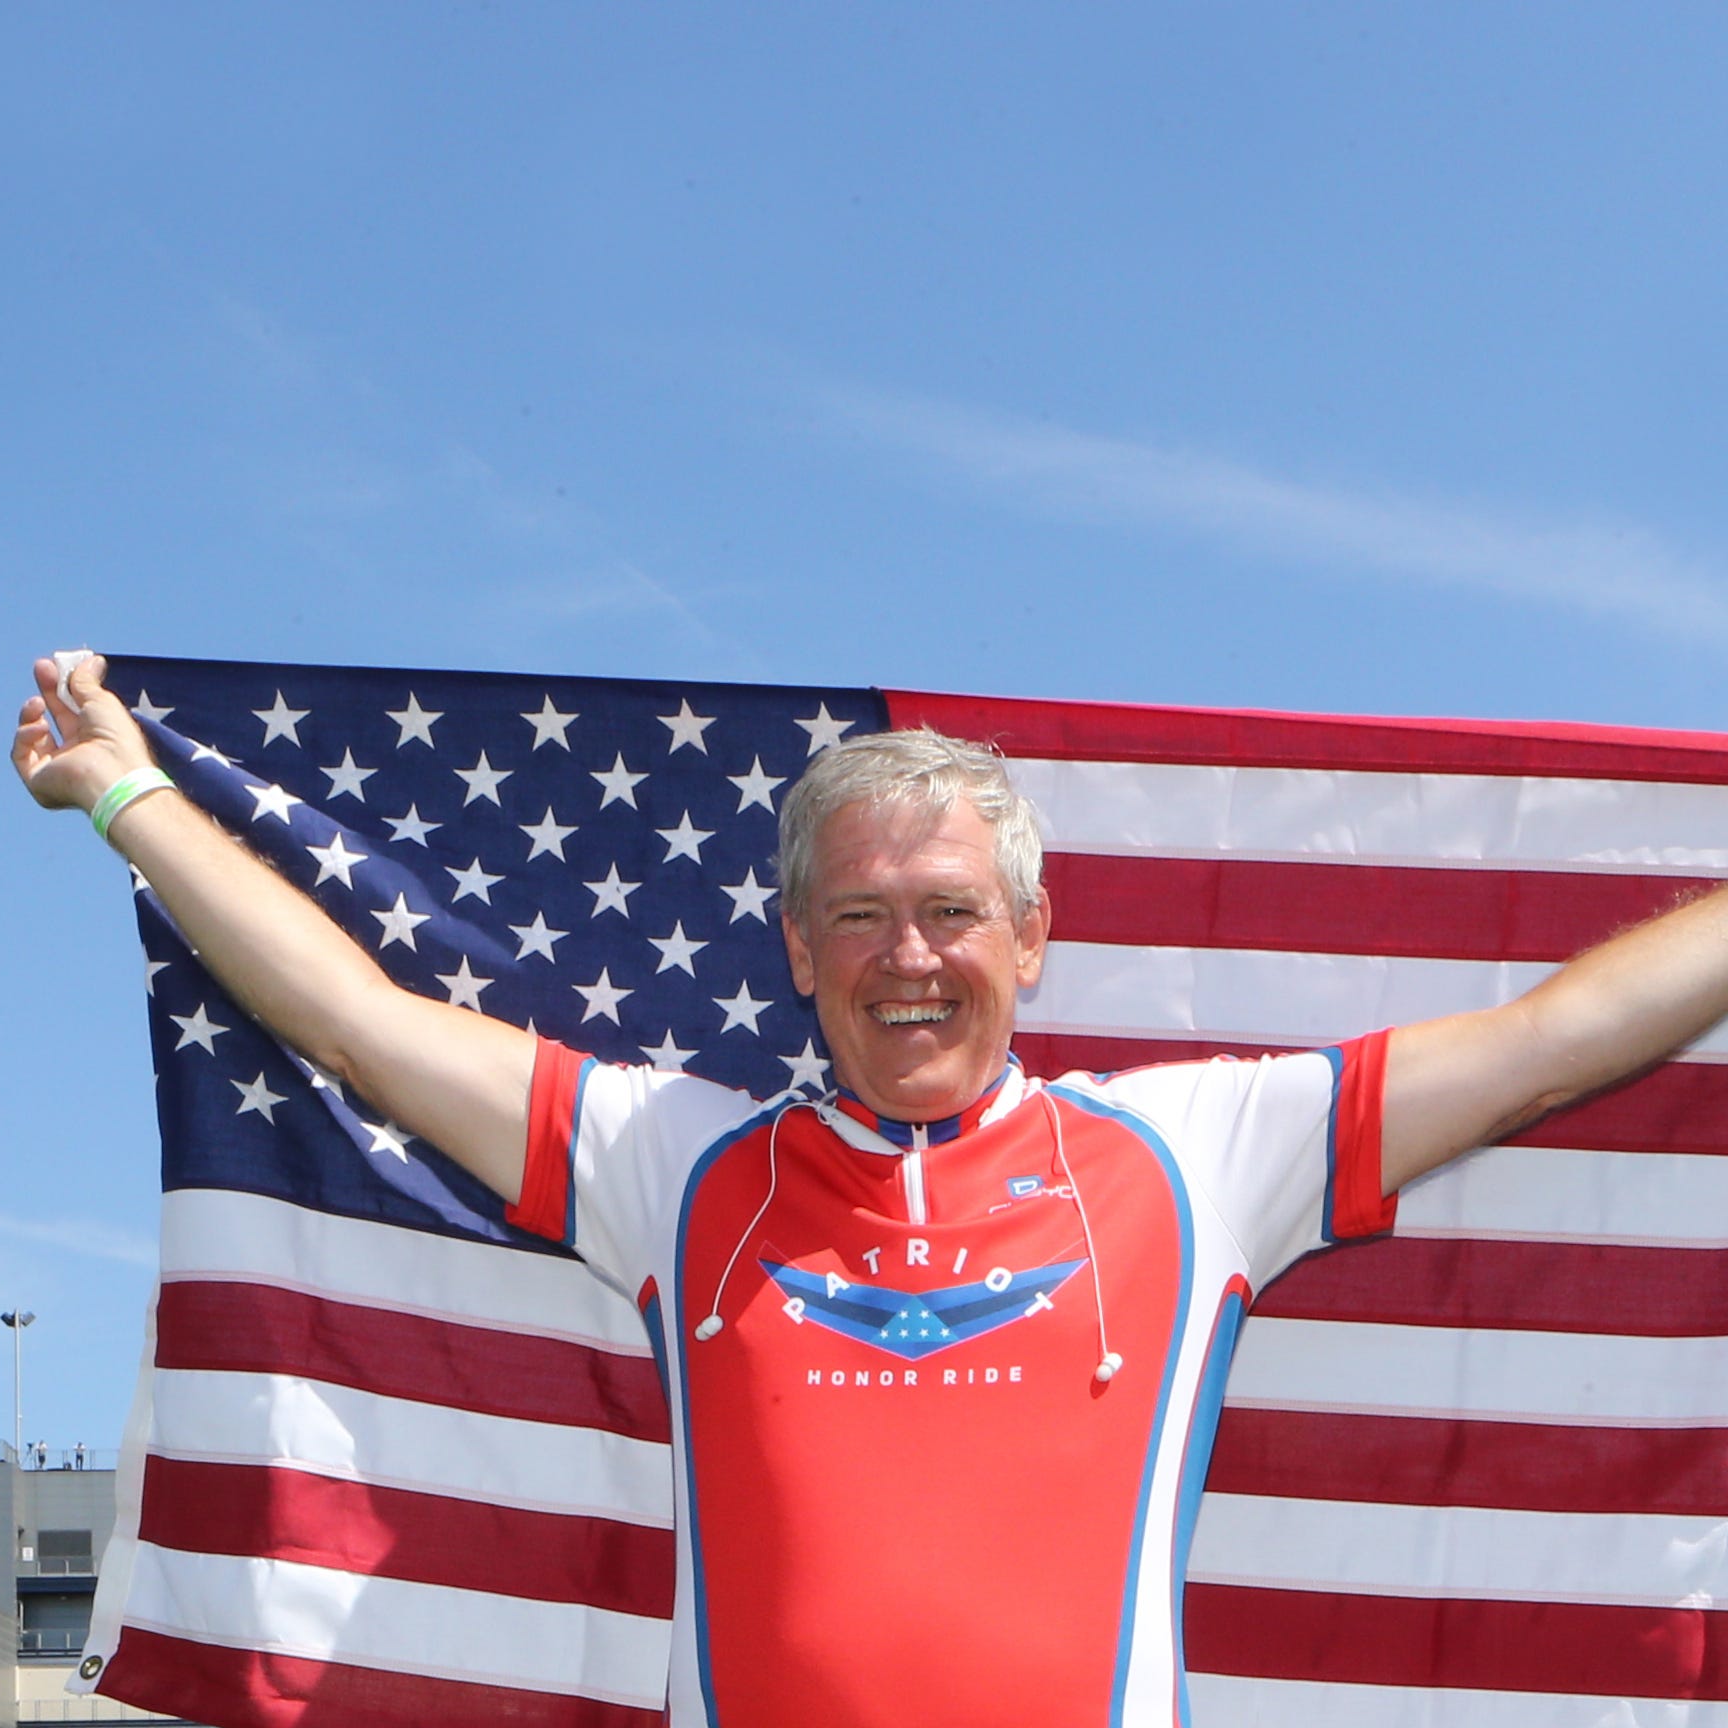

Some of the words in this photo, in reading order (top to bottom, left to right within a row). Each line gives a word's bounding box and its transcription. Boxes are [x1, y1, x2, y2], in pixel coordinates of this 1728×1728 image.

[781, 1238, 1055, 1325] PATRIOT
[807, 1369, 918, 1386] HONOR
[943, 1366, 1022, 1385] RIDE
